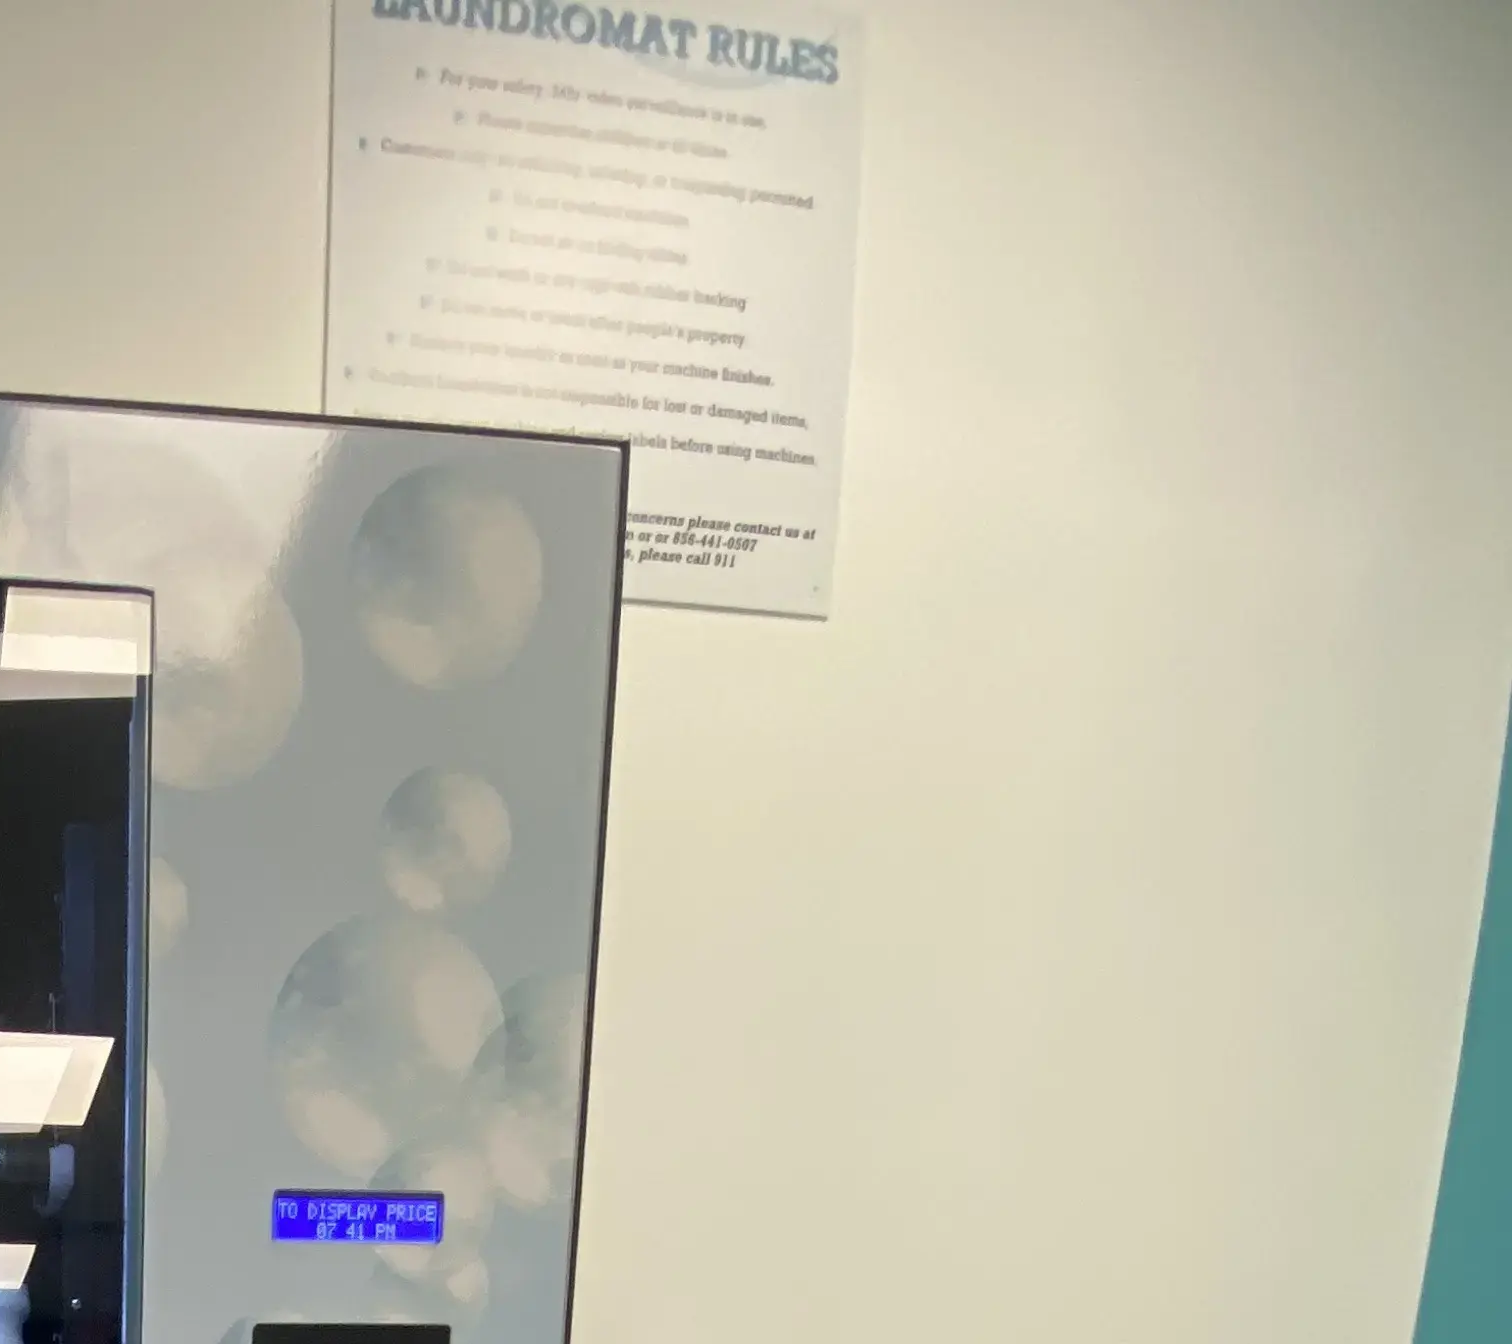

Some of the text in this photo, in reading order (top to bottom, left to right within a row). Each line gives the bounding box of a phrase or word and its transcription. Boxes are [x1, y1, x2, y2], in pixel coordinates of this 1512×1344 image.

[707, 24, 839, 84] RULES
[642, 396, 660, 411] for
[690, 404, 705, 416] or
[707, 403, 768, 425] damaged
[671, 437, 713, 455] before
[717, 442, 752, 462] using
[638, 531, 653, 542] or
[655, 533, 670, 545] or
[687, 515, 731, 533] please
[734, 522, 782, 537] contact
[785, 527, 800, 539] us
[803, 528, 816, 540] at
[638, 547, 682, 563] please
[687, 551, 711, 566] call
[714, 552, 736, 568] 911
[279, 1202, 437, 1223] TO DISPLAY PRICE
[375, 1223, 397, 1241] PM
